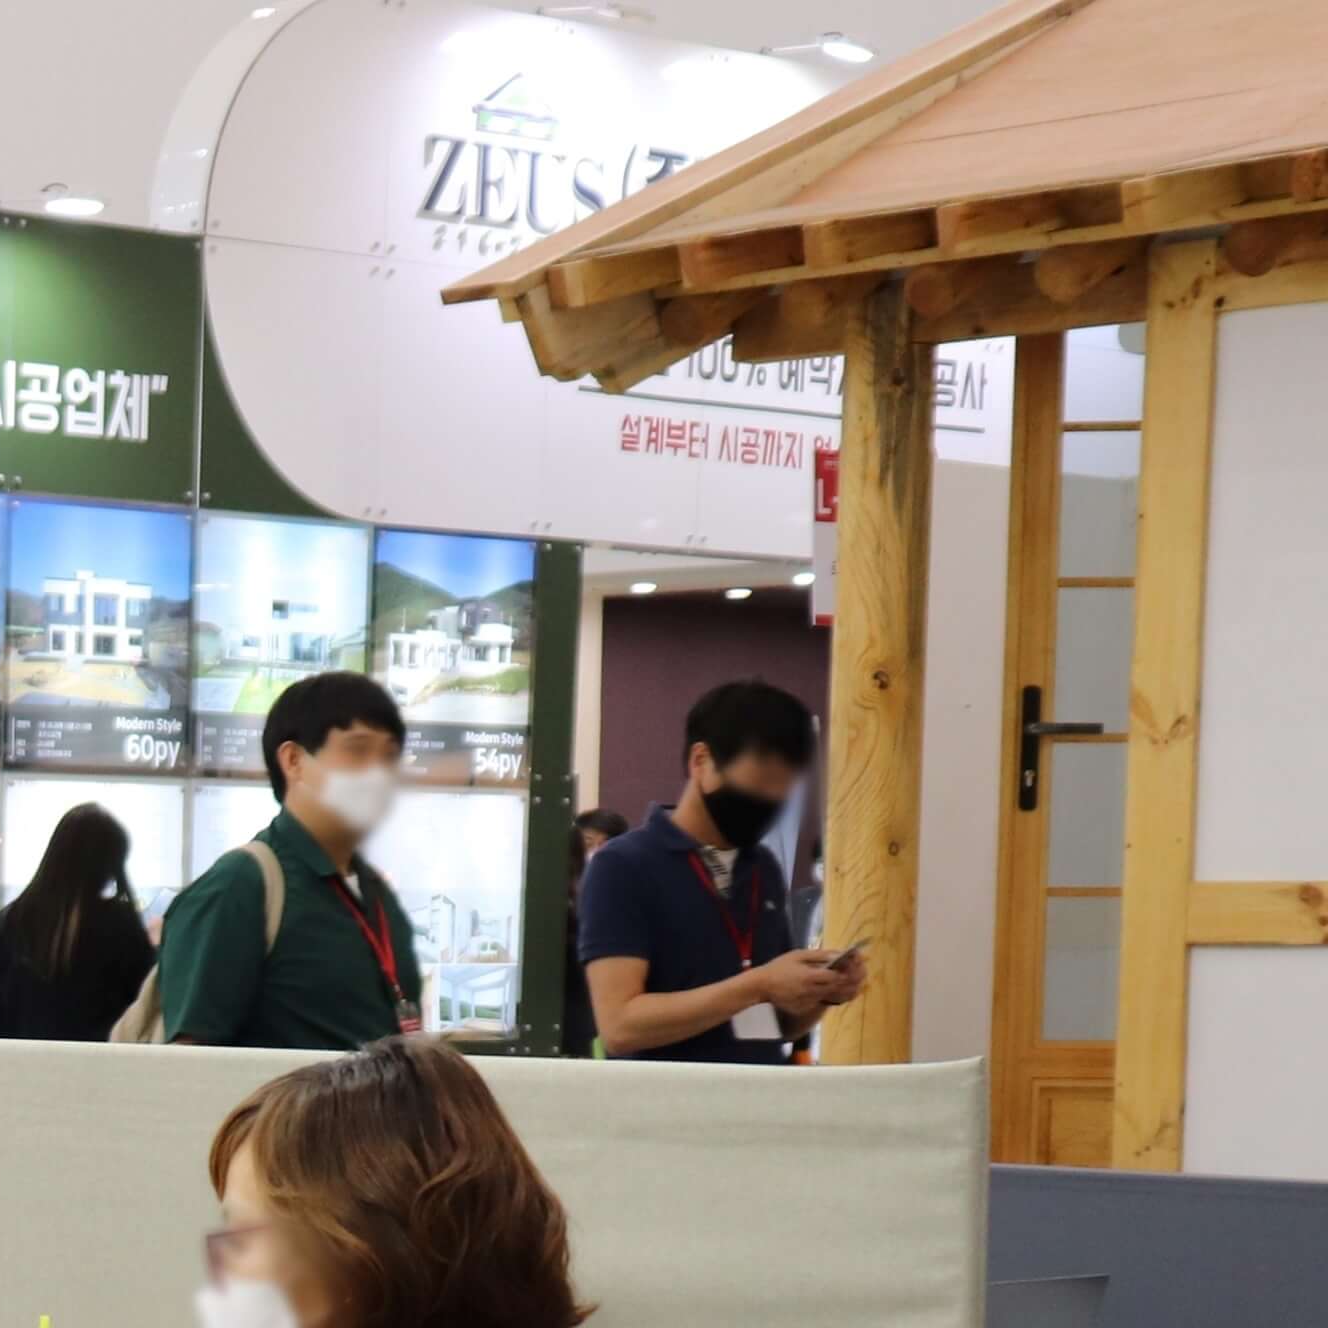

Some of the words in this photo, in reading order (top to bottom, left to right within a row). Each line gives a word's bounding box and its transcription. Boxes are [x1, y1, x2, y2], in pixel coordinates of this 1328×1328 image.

[416, 133, 607, 235] ZEUS
[621, 414, 709, 460] 설계부터
[718, 425, 803, 469] 시공까지
[115, 716, 154, 732] Modern
[156, 718, 182, 734] Style
[465, 731, 499, 746] Modern
[500, 733, 524, 747] Style
[127, 733, 181, 768] 60py
[475, 748, 522, 780] 54py
